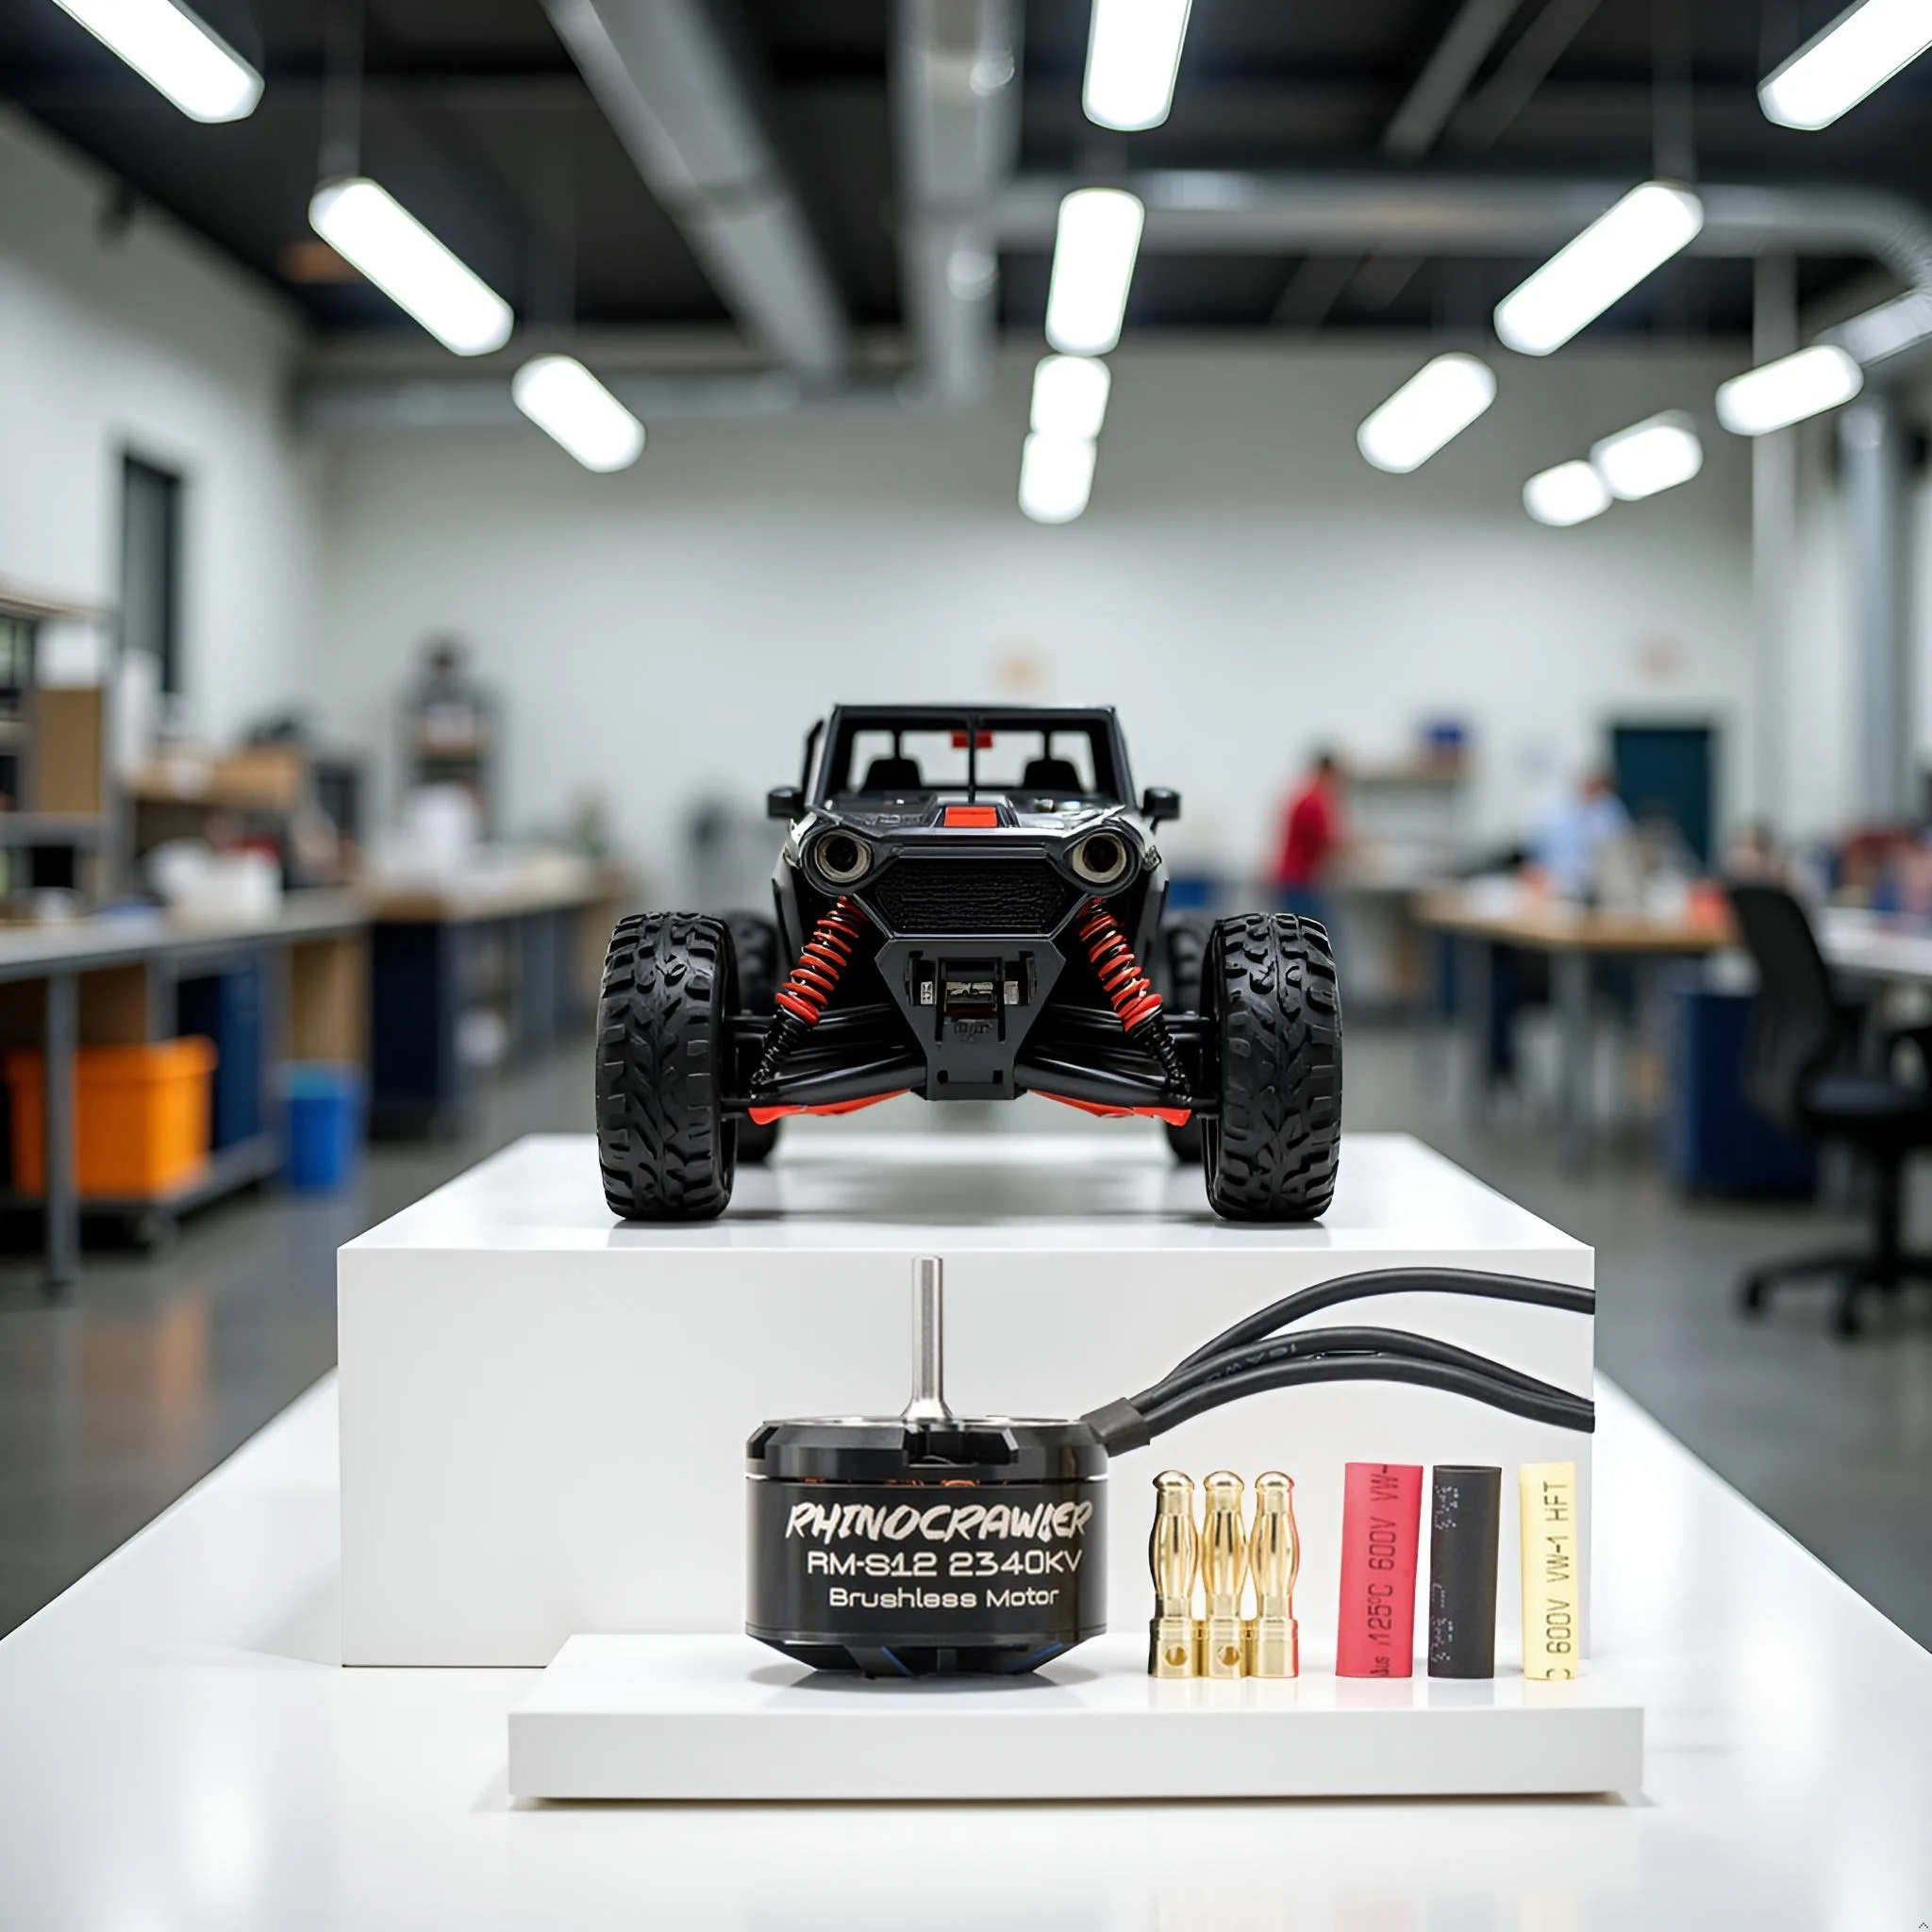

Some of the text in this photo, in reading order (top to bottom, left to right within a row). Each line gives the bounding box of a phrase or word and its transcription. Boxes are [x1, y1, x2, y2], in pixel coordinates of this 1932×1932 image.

[785, 1500, 1093, 1545] RHINOCRAWLER
[1543, 1481, 1569, 1522] HFT
[808, 1549, 1083, 1576] RM-S12 2340KV
[1368, 1516, 1397, 1571] 600V
[1545, 1535, 1570, 1583] VW-1
[829, 1587, 1059, 1608] Brushless Motor
[1545, 1598, 1572, 1655] 600V
